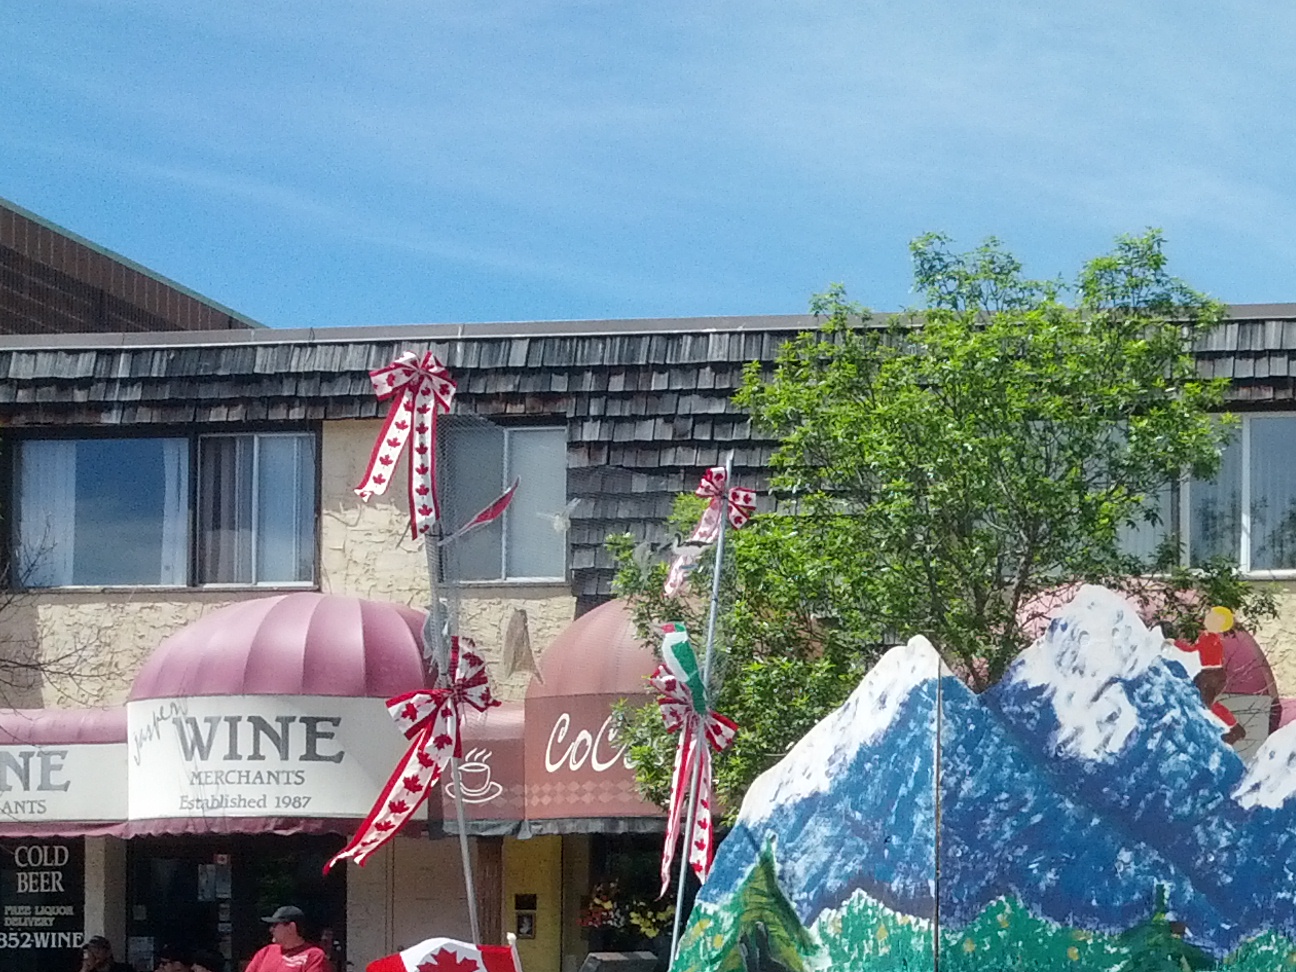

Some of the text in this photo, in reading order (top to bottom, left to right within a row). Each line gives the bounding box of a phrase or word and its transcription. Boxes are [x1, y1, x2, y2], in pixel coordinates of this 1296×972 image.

[172, 715, 345, 763] WINE
[0, 750, 70, 791] NE
[190, 770, 306, 785] MERCHANTS
[0, 799, 47, 814] ANTS
[179, 794, 312, 810] Established 1987
[14, 845, 69, 867] COLD
[16, 871, 64, 893] BEER
[4, 917, 55, 927] DELIVERY
